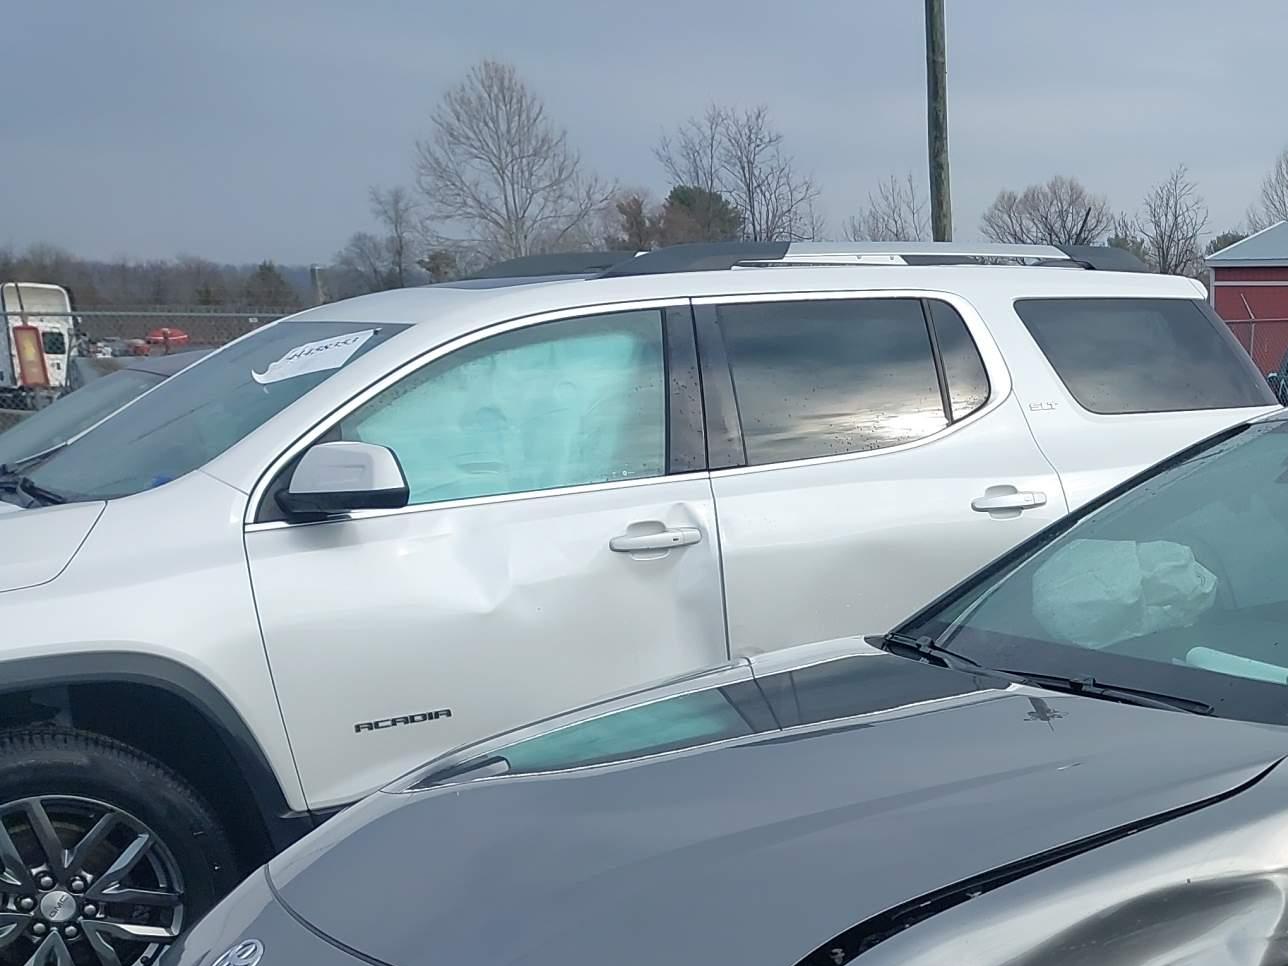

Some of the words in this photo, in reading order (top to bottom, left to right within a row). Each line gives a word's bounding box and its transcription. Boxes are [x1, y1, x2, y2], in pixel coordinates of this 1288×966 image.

[1029, 402, 1059, 411] SLT
[354, 709, 452, 733] ACADIA
[49, 895, 65, 918] GMC
